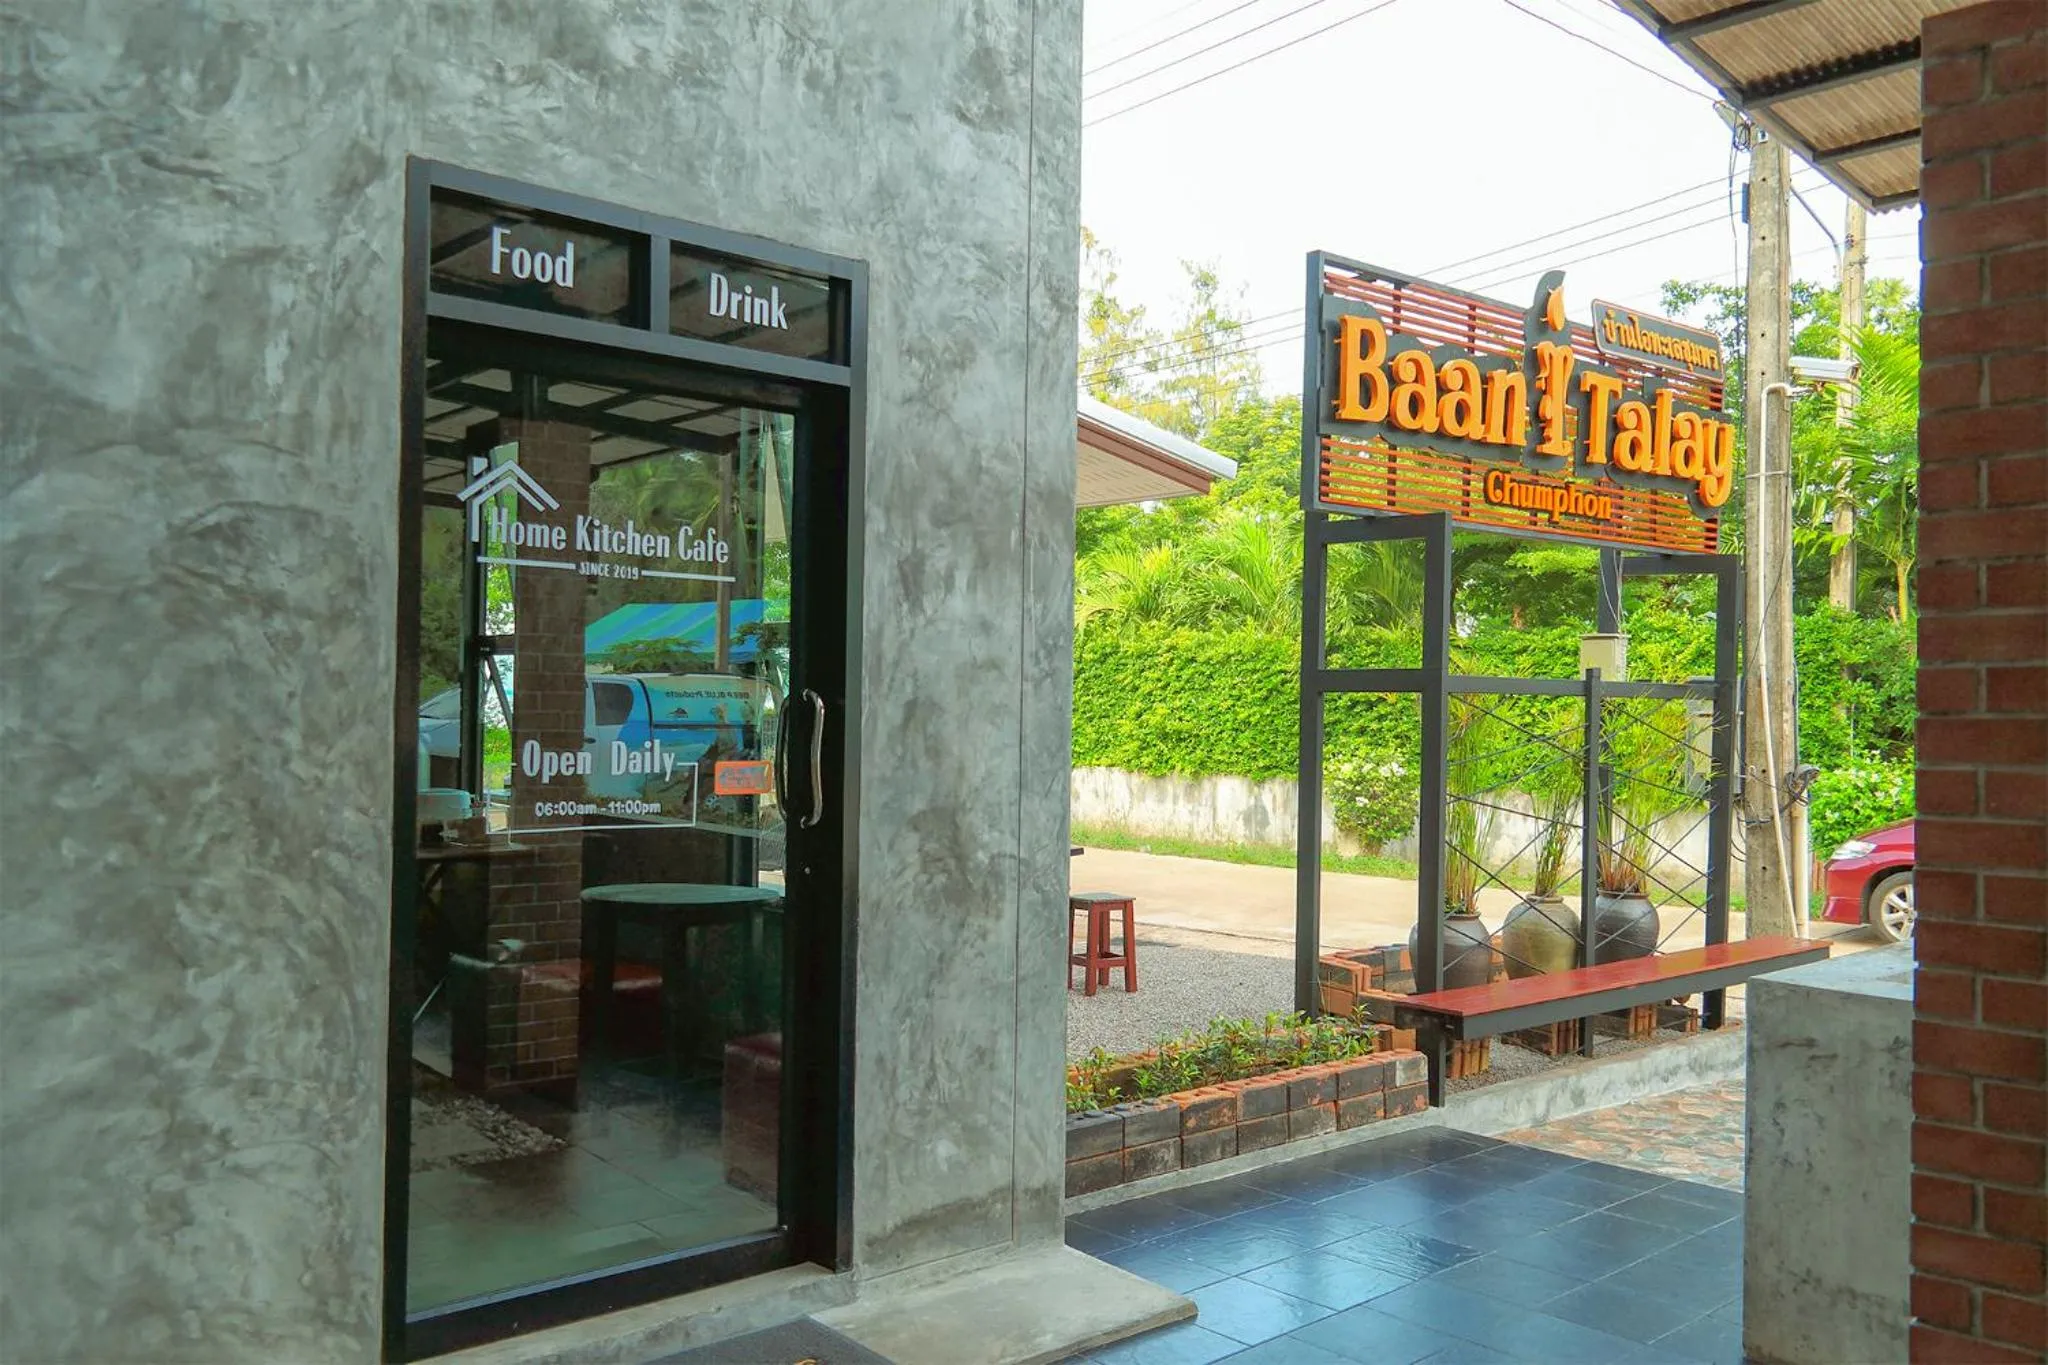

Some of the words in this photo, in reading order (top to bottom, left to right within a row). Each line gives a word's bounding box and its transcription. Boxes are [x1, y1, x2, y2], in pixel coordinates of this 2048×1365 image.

[490, 226, 575, 288] Food
[708, 272, 788, 331] Drink
[1335, 314, 1528, 447] Baan
[1580, 371, 1734, 508] Talay
[1484, 470, 1613, 523] Chumphon
[490, 505, 567, 550] Home
[575, 514, 670, 558] Kitchen
[678, 525, 729, 563] Cafe
[579, 562, 611, 577] SINCE
[613, 565, 639, 580] 2019
[522, 739, 592, 784] Open
[611, 739, 675, 782] Daily
